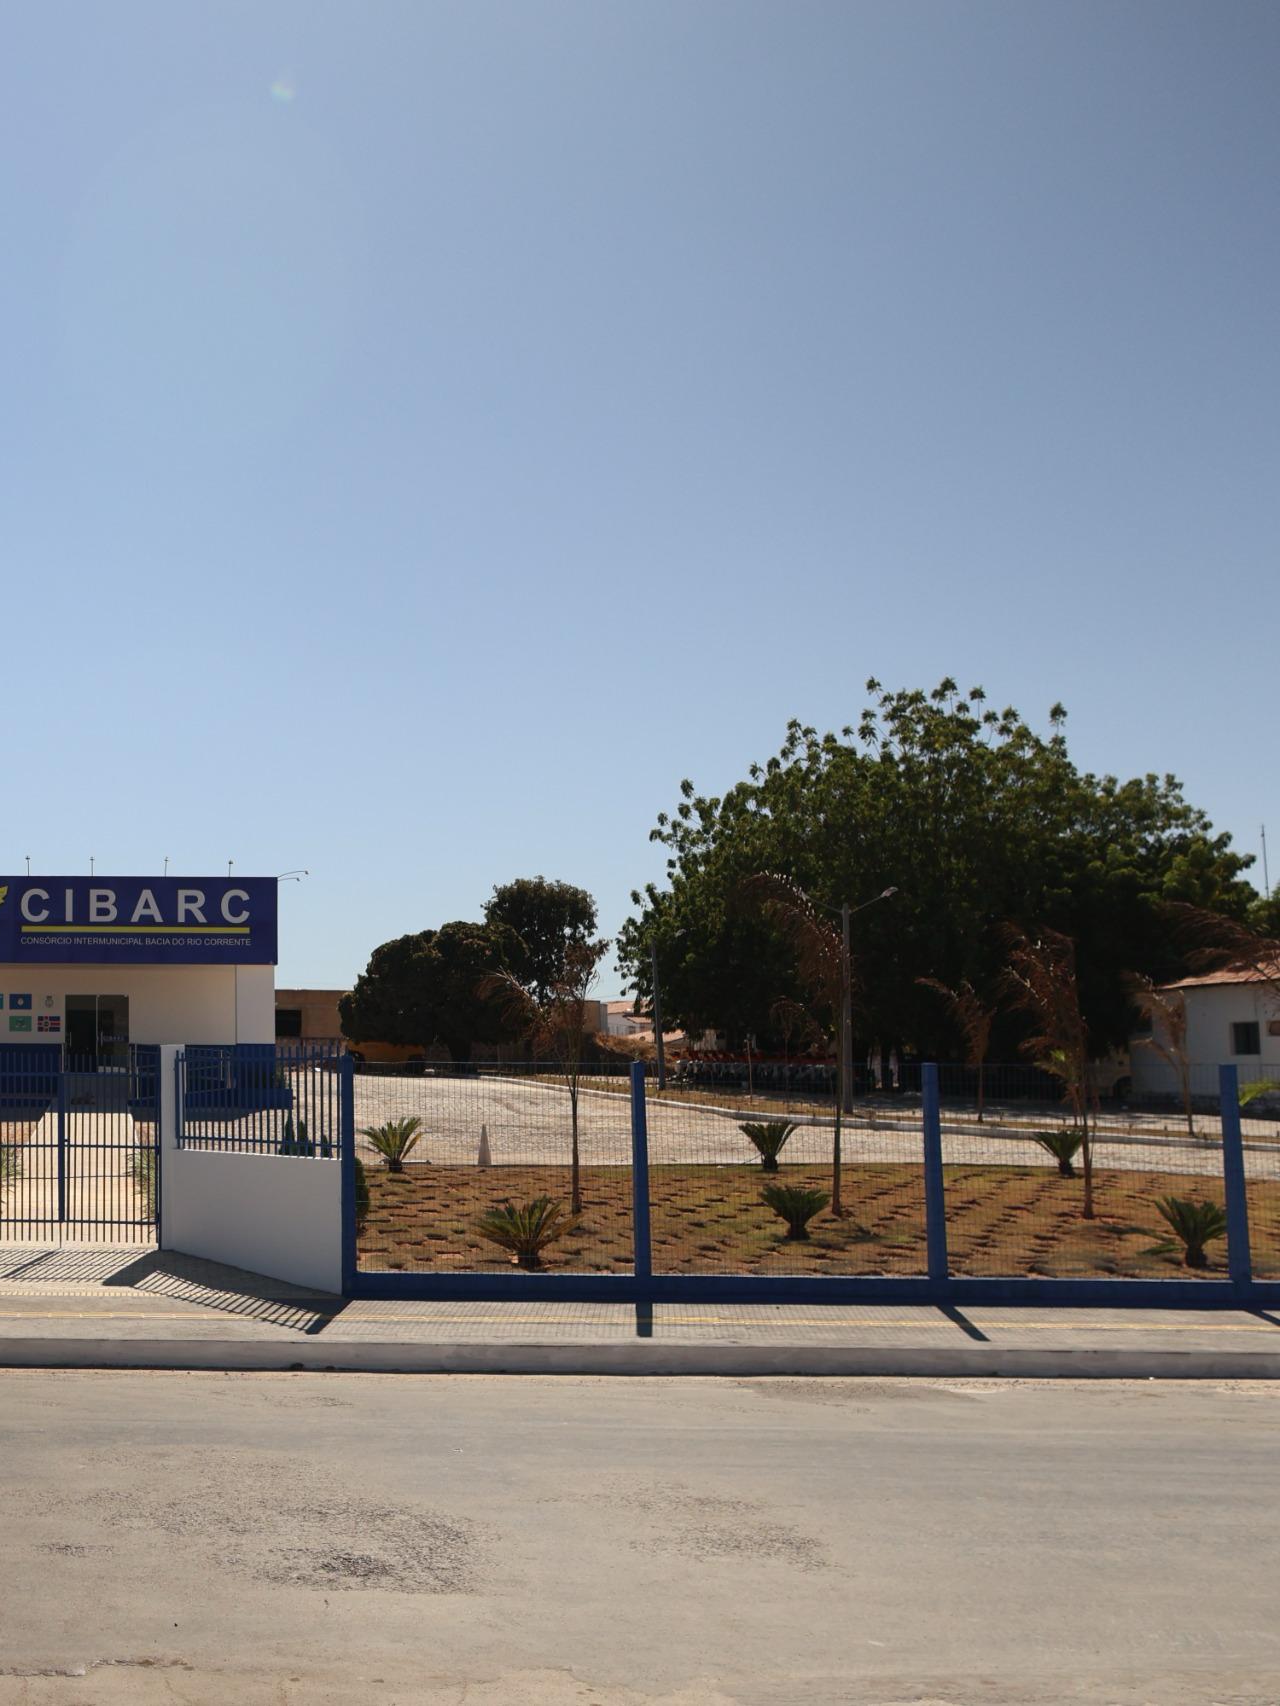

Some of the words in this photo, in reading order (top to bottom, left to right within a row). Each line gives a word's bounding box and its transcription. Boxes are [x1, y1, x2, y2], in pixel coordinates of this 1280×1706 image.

[20, 887, 251, 924] CIBARC
[20, 935, 72, 945] CONSÓRCIO
[73, 936, 144, 946] INTERMUNICIPAL
[145, 937, 171, 946] BACIA
[171, 937, 186, 946] DO
[186, 937, 202, 946] RIO
[203, 938, 251, 947] CORRENTE
